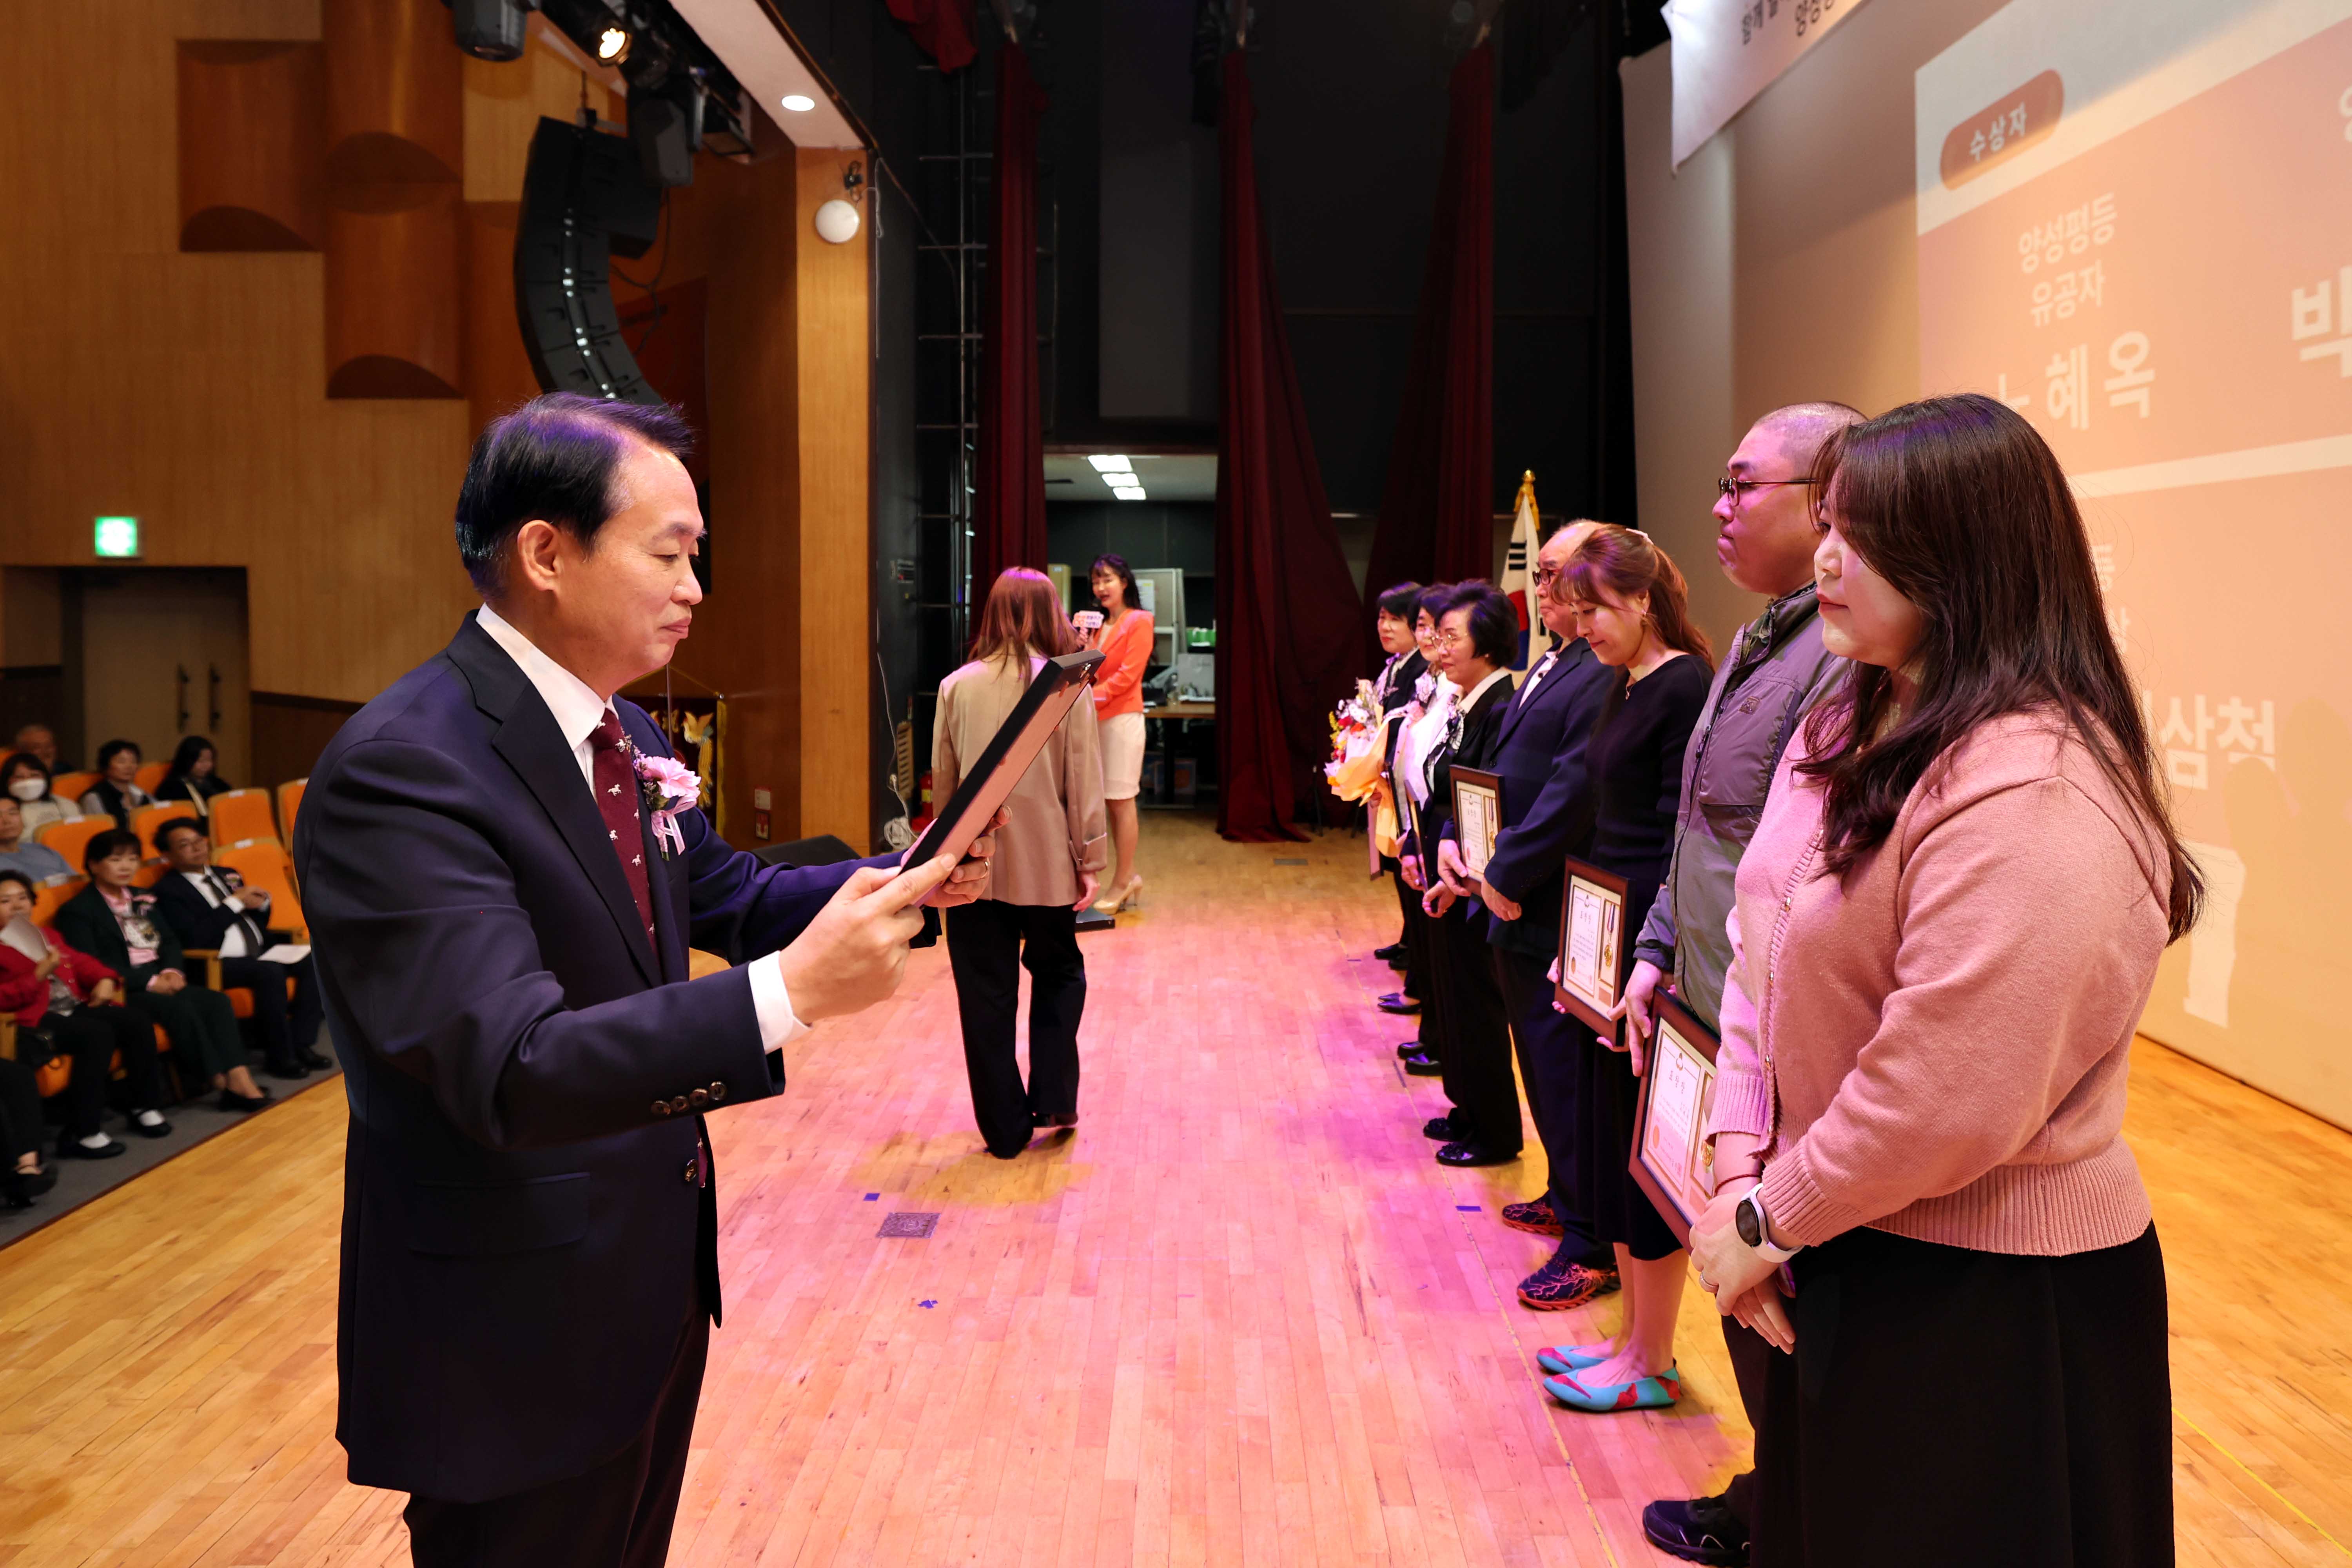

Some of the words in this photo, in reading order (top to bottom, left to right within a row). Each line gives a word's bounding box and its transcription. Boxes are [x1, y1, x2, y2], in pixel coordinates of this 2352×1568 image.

[1795, 0, 1834, 36] 양성
[1969, 102, 2027, 162] 수상자
[2019, 192, 2117, 274] 양성평등
[2030, 259, 2105, 327] 유공자
[1669, 1070, 1685, 1094] 표창장
